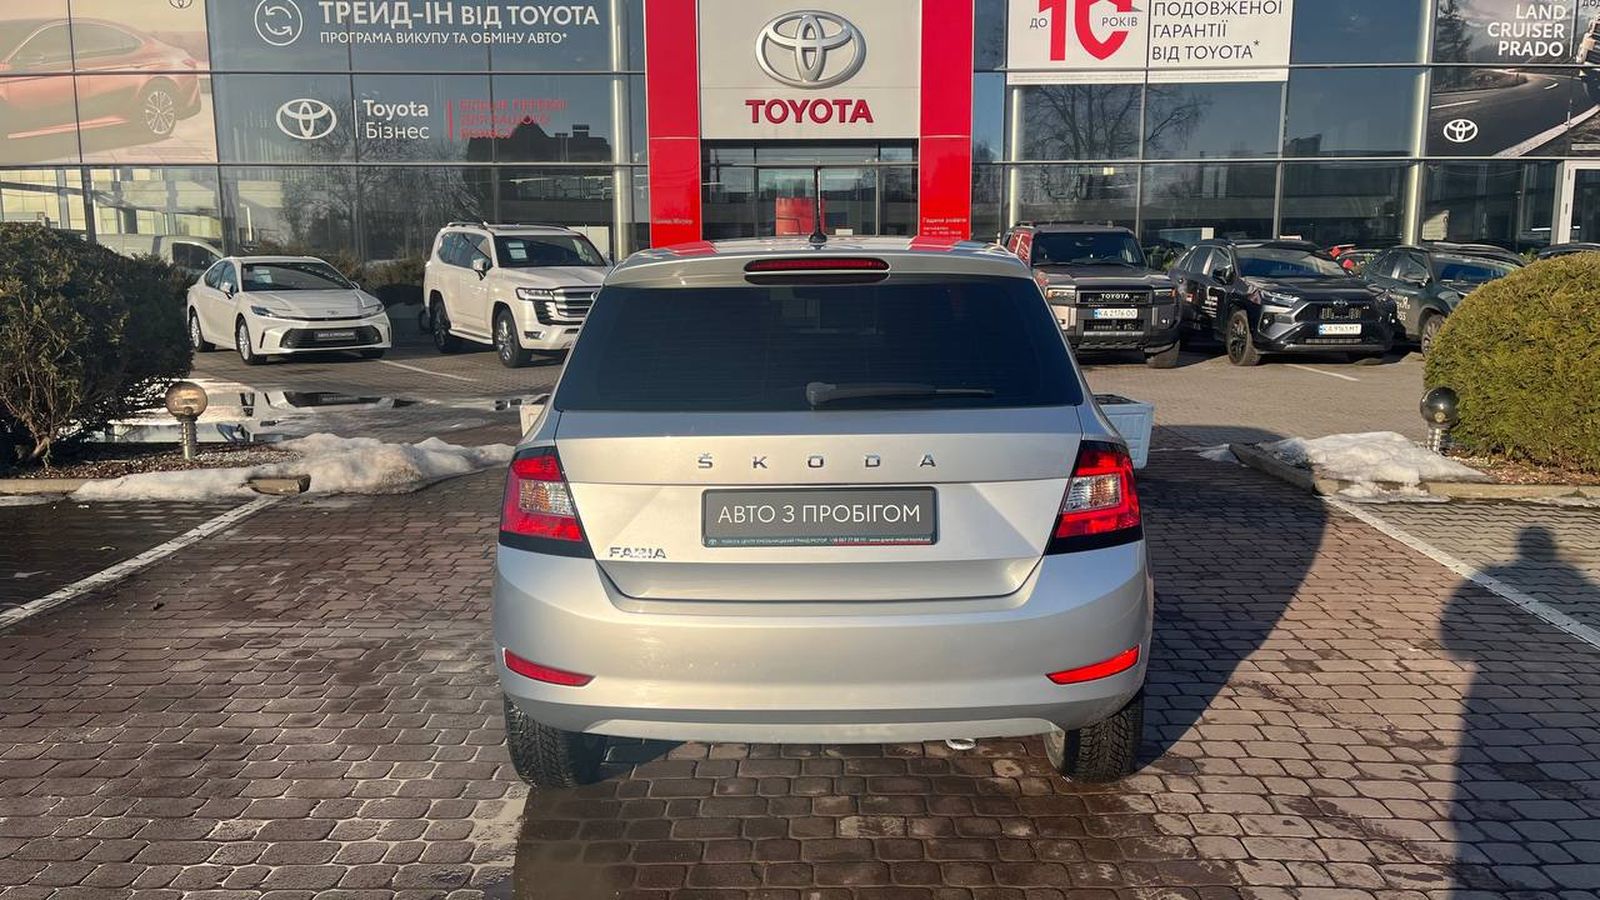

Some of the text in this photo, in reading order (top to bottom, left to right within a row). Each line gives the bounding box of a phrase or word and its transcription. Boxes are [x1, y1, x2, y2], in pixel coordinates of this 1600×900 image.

[461, 5, 502, 29] ВІД
[506, 5, 600, 25] TOYOTA
[1516, 4, 1566, 20] LAND
[1029, 18, 1048, 29] ДО
[1101, 16, 1138, 27] РОКІВ
[1153, 19, 1228, 38] ГАРАНТІЇ
[1487, 21, 1565, 39] CRUISER
[320, 31, 393, 44] ПРОГРАМА
[395, 31, 450, 44] ВИКУПУ
[452, 32, 468, 44] ТА
[470, 32, 525, 44] ОБМІНУ
[1152, 45, 1180, 63] ВІД
[1498, 40, 1564, 57] PRADO
[362, 99, 429, 121] Toyota
[745, 98, 874, 124] TOYOTA
[365, 121, 430, 139] Бізнес
[697, 452, 938, 469] ŠKODA
[717, 504, 921, 524] АВТО З ПРОБІГОМ
